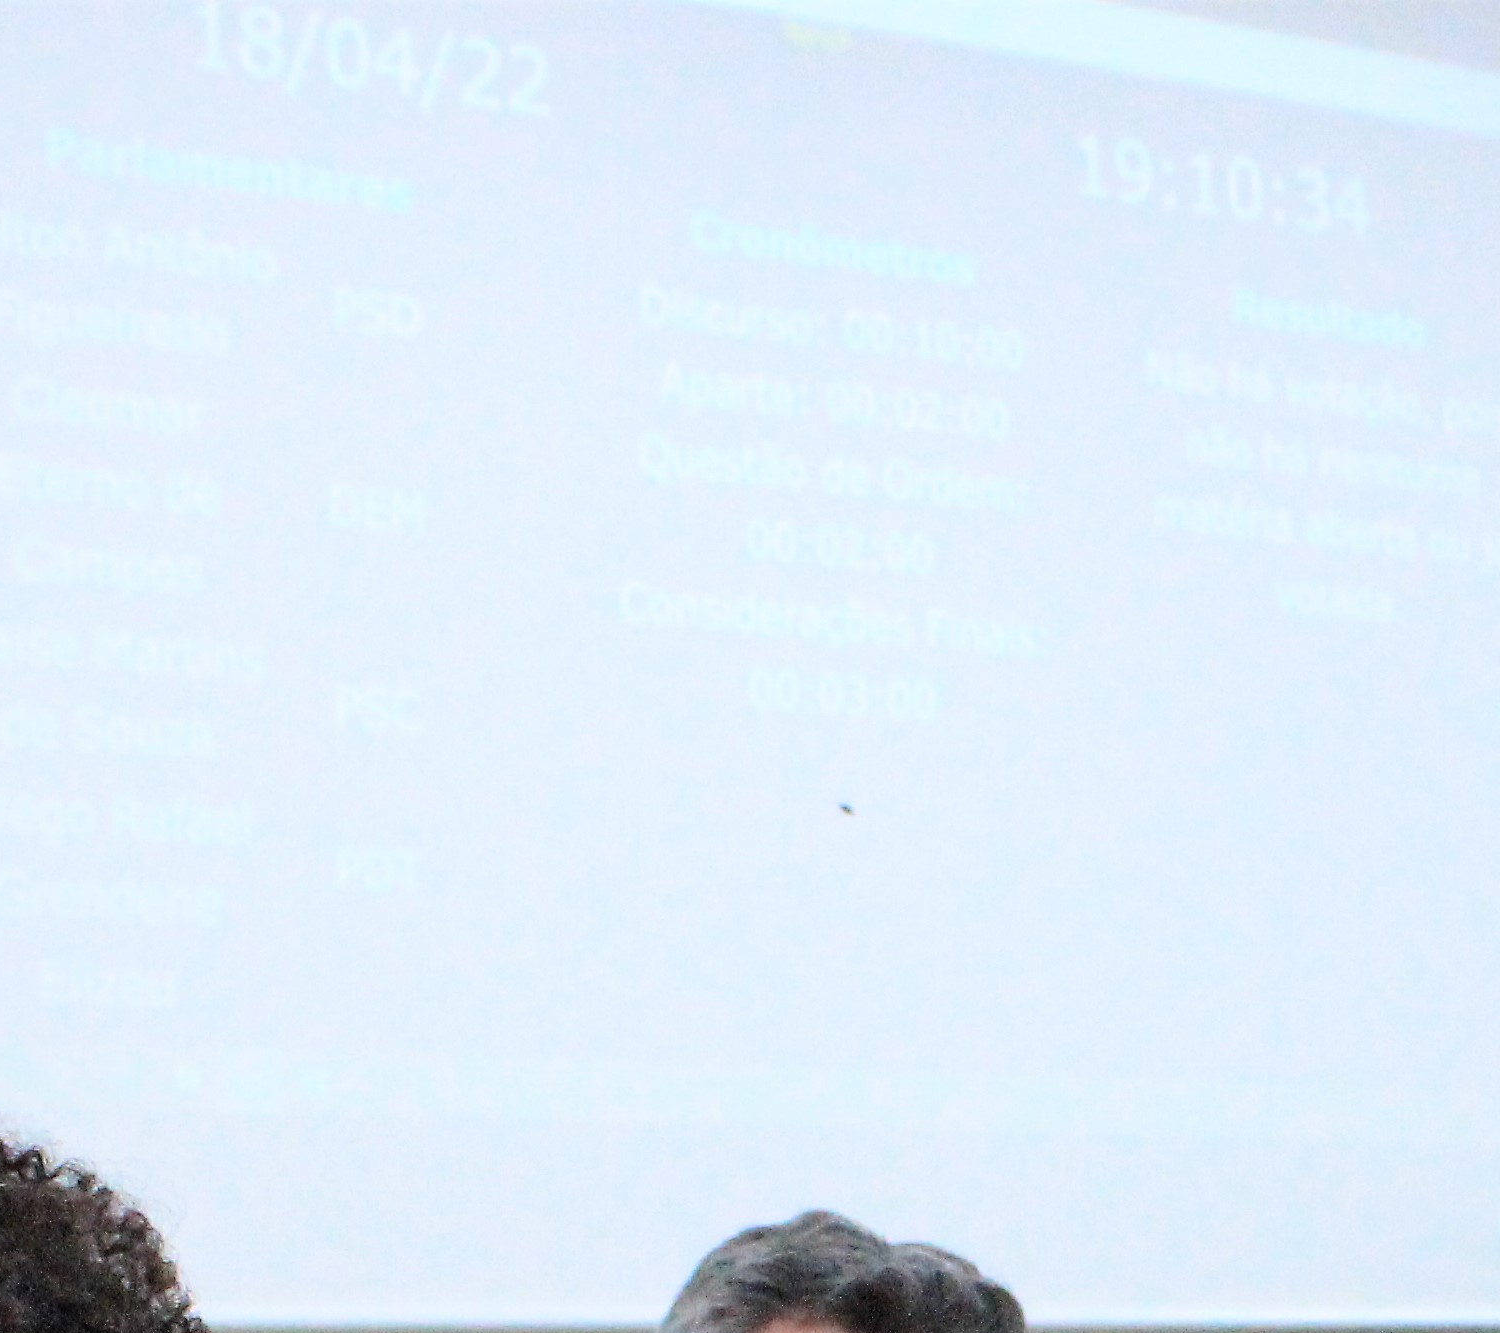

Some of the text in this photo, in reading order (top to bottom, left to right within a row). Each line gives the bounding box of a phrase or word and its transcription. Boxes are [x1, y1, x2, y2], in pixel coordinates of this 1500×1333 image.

[194, 2, 552, 118] 18/04/22
[1080, 134, 1372, 238] 19:10:34
[332, 286, 425, 341] PSD
[639, 280, 1026, 373] Discurso: 00:10:00
[659, 360, 1011, 441] Aparte: 00:02:00
[638, 430, 808, 492] Questão
[821, 456, 870, 498] de
[329, 481, 428, 536] DEM
[746, 515, 935, 576] 00:02:00
[335, 684, 426, 738] PSC
[748, 665, 937, 723] 00:03:00
